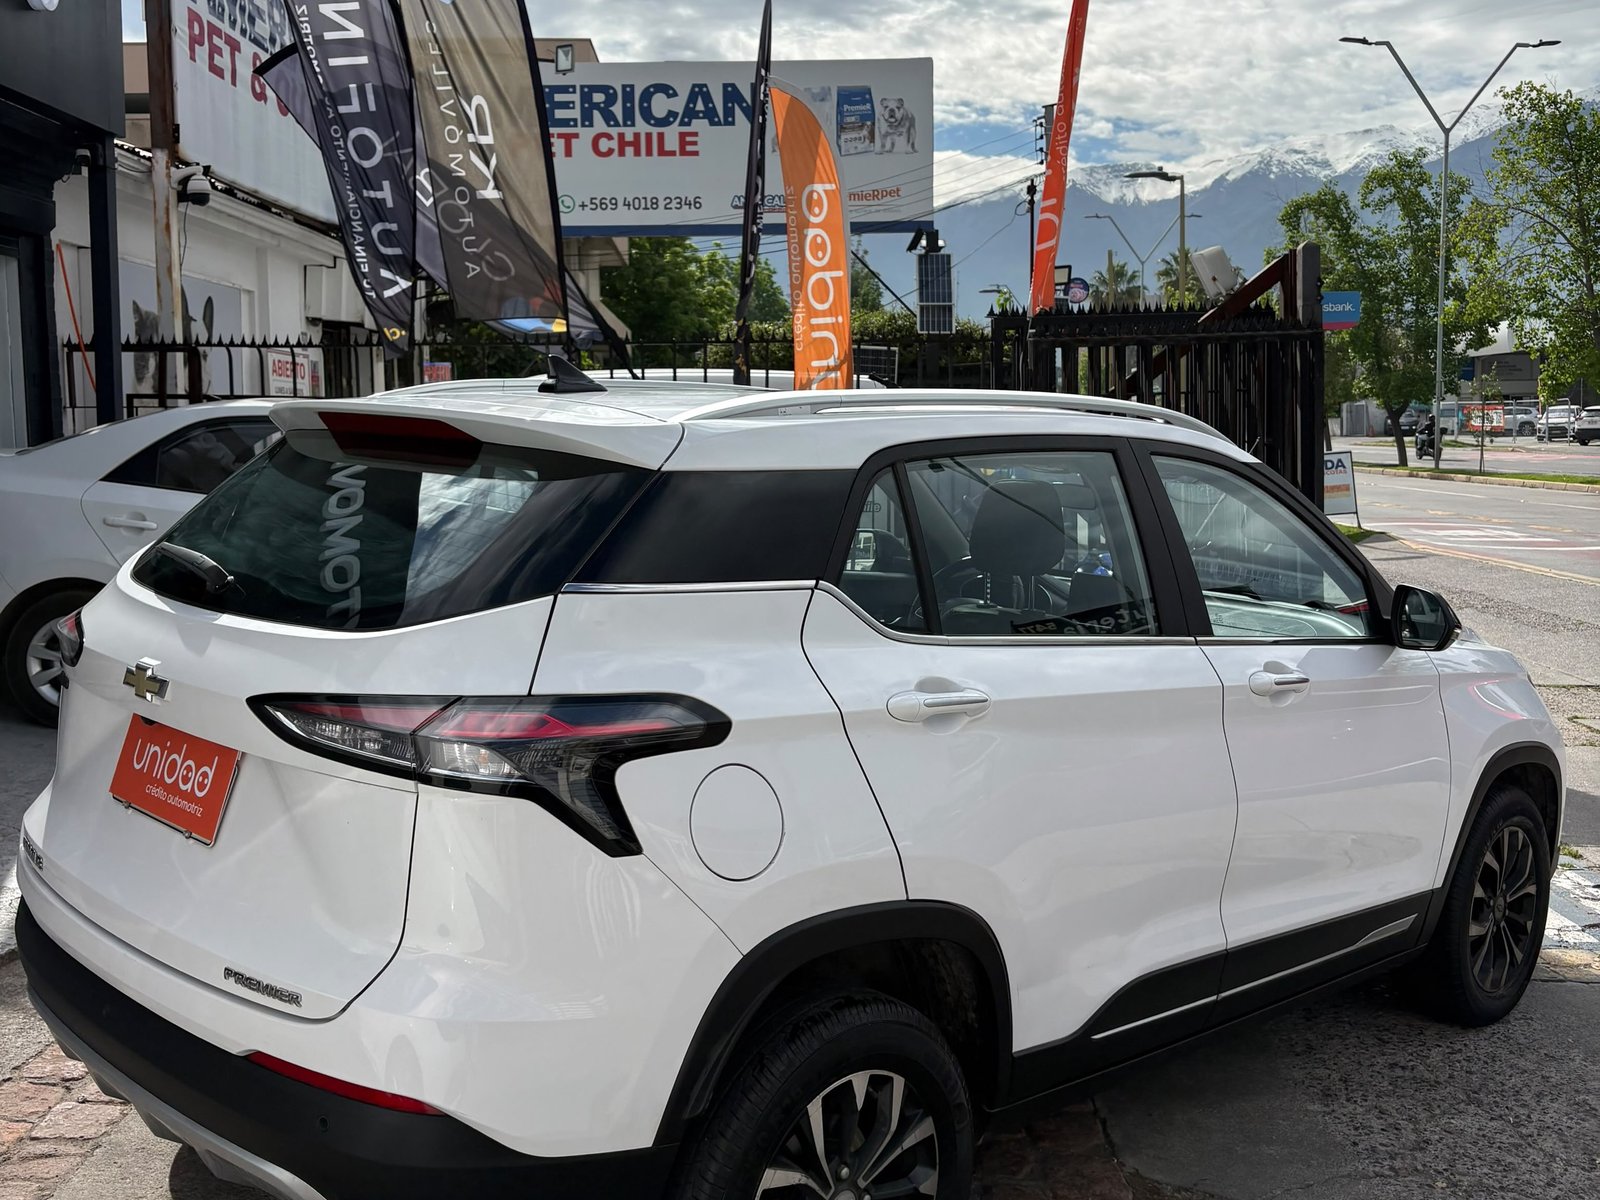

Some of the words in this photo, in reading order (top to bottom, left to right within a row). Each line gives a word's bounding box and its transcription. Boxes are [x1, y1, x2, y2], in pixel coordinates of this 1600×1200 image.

[187, 6, 242, 88] PET
[543, 83, 757, 128] ERICAN
[591, 131, 699, 158] CHILE
[578, 196, 618, 211] +569
[622, 196, 660, 211] 4018
[663, 196, 703, 211] 2346
[848, 187, 902, 202] mieRpet
[1322, 302, 1356, 312] sbank.
[1324, 457, 1347, 471] DA
[133, 738, 219, 798] unidad
[145, 783, 168, 801] crédito
[166, 792, 204, 817] automotriz
[223, 966, 302, 1008] PREMIER
